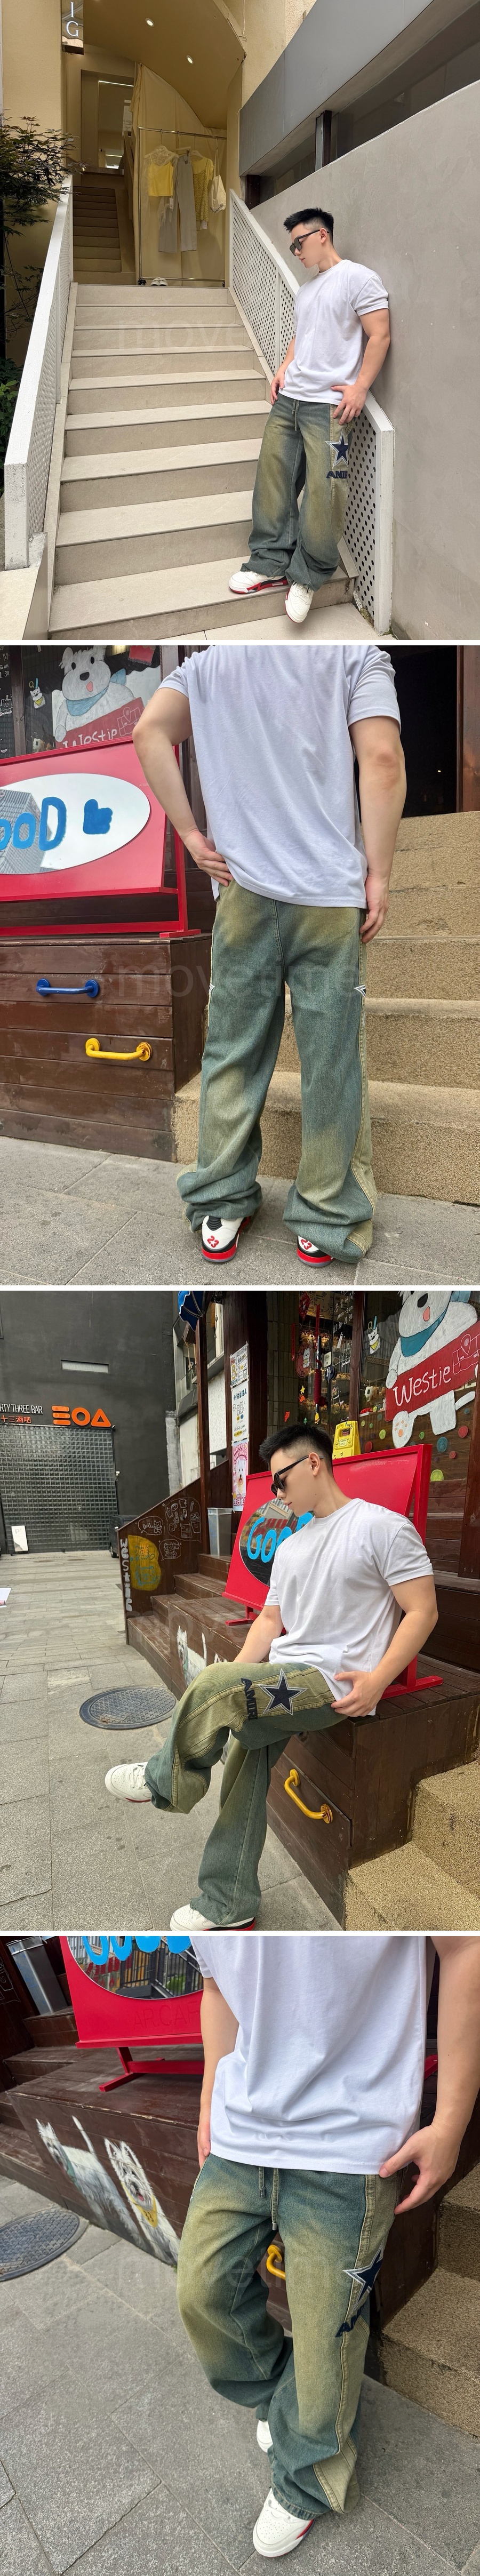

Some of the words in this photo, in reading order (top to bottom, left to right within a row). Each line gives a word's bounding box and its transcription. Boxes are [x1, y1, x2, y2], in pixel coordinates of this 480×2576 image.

[207, 1235, 219, 1247] 23
[300, 1238, 313, 1250] 23
[393, 1366, 452, 1406] Westie
[11, 1404, 30, 1413] THREE
[31, 1405, 43, 1414] BAR
[0, 1415, 32, 1423] 十三酒吧
